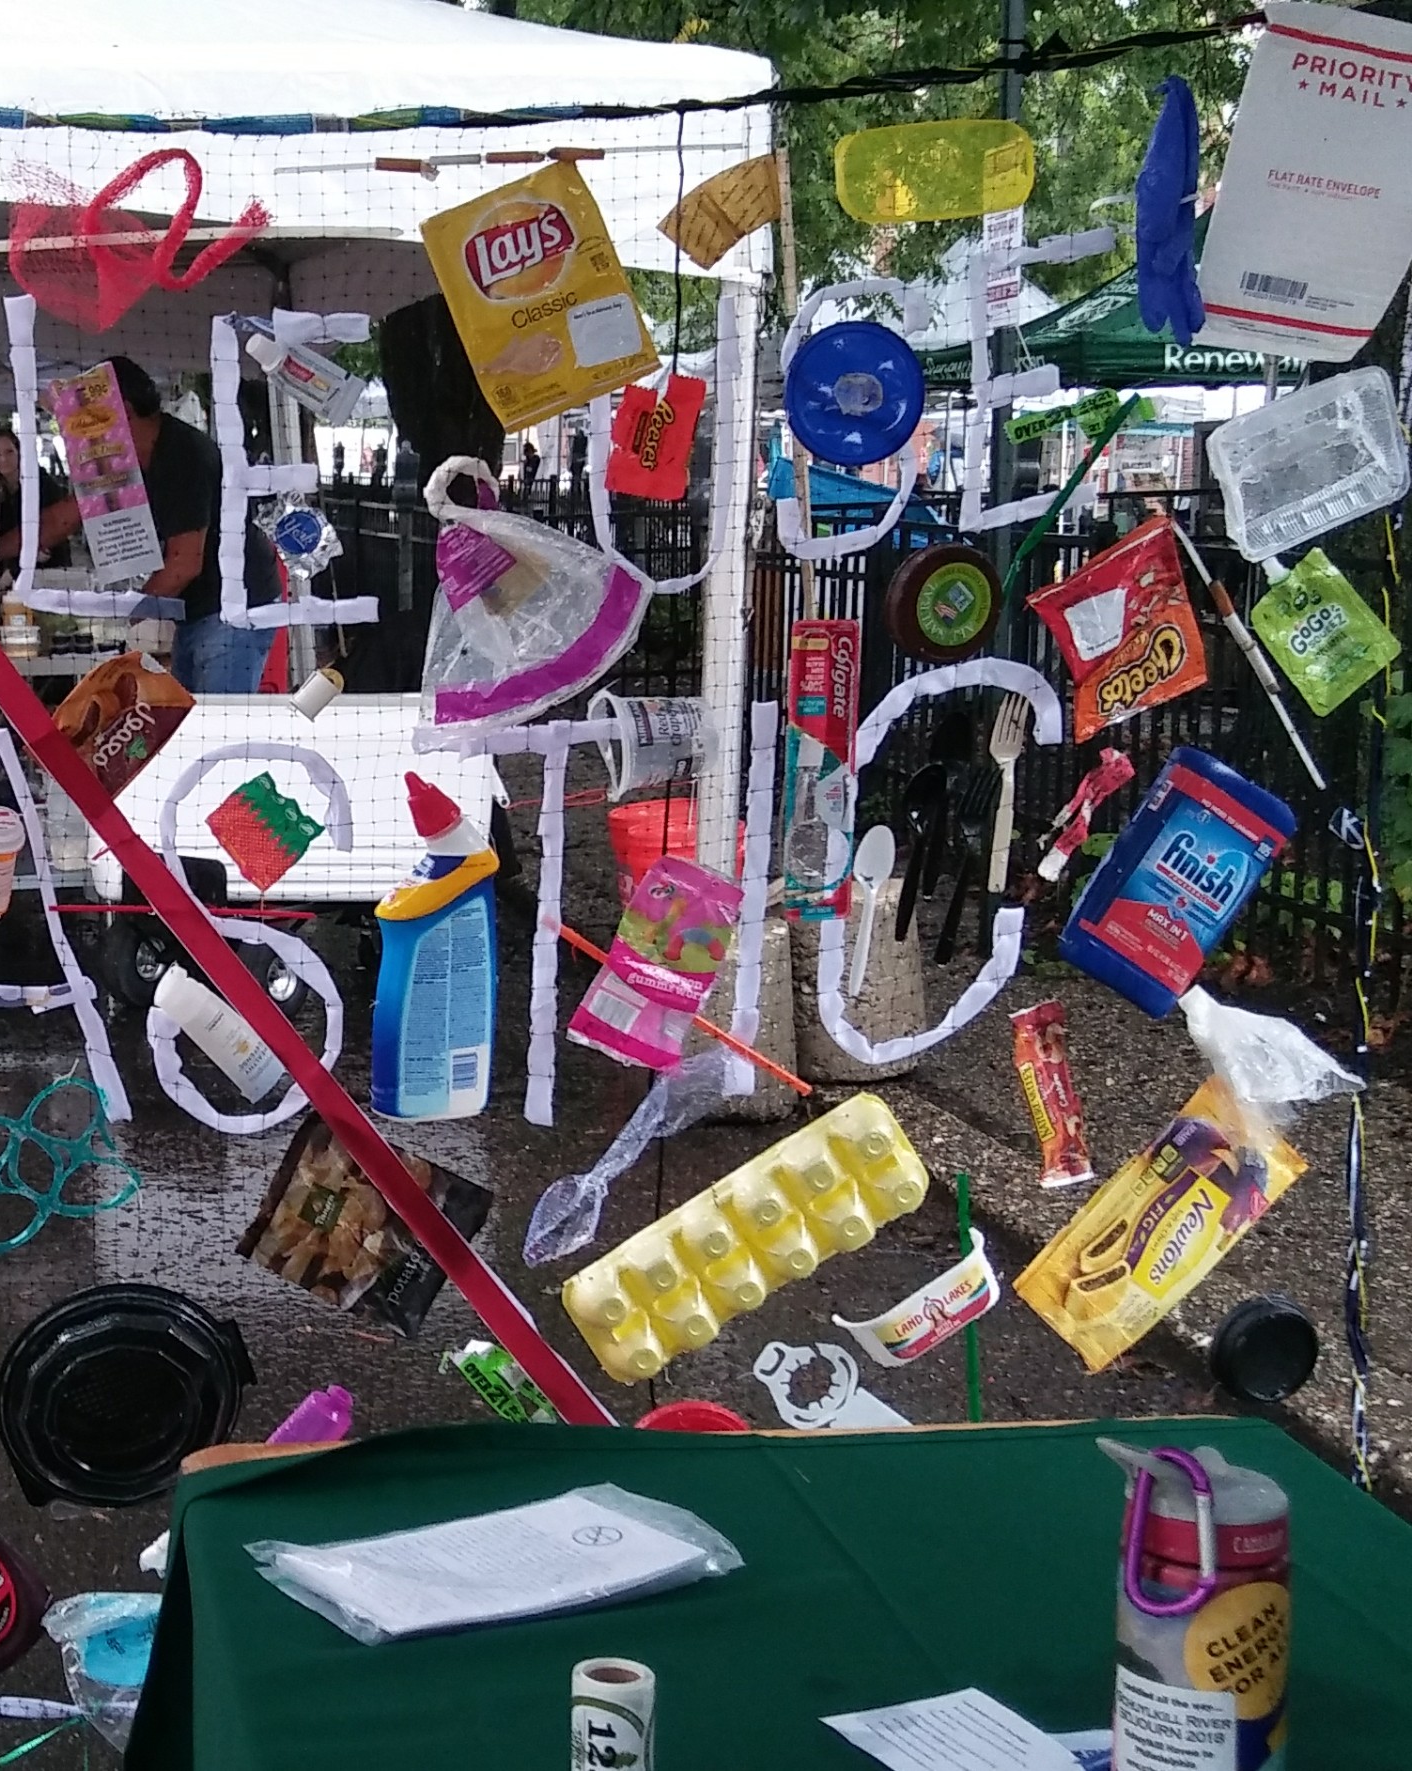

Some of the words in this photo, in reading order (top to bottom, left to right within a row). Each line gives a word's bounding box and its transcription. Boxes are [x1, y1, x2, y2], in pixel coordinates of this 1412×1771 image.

[1292, 53, 1412, 93] PRIORITY
[1319, 82, 1384, 107] MAIL
[1268, 169, 1292, 182] FLAT
[1295, 174, 1324, 188] RATE
[1326, 179, 1381, 198] ENVELOPE
[511, 291, 579, 329] Classic
[1015, 420, 1048, 440] OVER
[278, 516, 321, 547] York
[920, 582, 946, 638] NATURAL
[1290, 606, 1332, 656] GoGo
[830, 635, 856, 719] Colgate
[1099, 626, 1183, 709] Cheetos
[92, 701, 156, 772] معمول
[655, 706, 670, 737] Red
[1146, 907, 1171, 931] MAX
[1020, 1064, 1041, 1102] VALLEY
[1036, 1101, 1054, 1141] NATURE
[1143, 1205, 1167, 1232] FIG
[1149, 1188, 1215, 1286] Newtons
[387, 1249, 422, 1306] potato
[893, 1313, 924, 1341] LAND
[942, 1279, 973, 1305] LAKES
[463, 1360, 493, 1394] OVER
[485, 1382, 511, 1410] 21
[1206, 1603, 1277, 1658] CLEAN
[1185, 1713, 1232, 1730] RIVER
[1185, 1730, 1226, 1745] 2018
